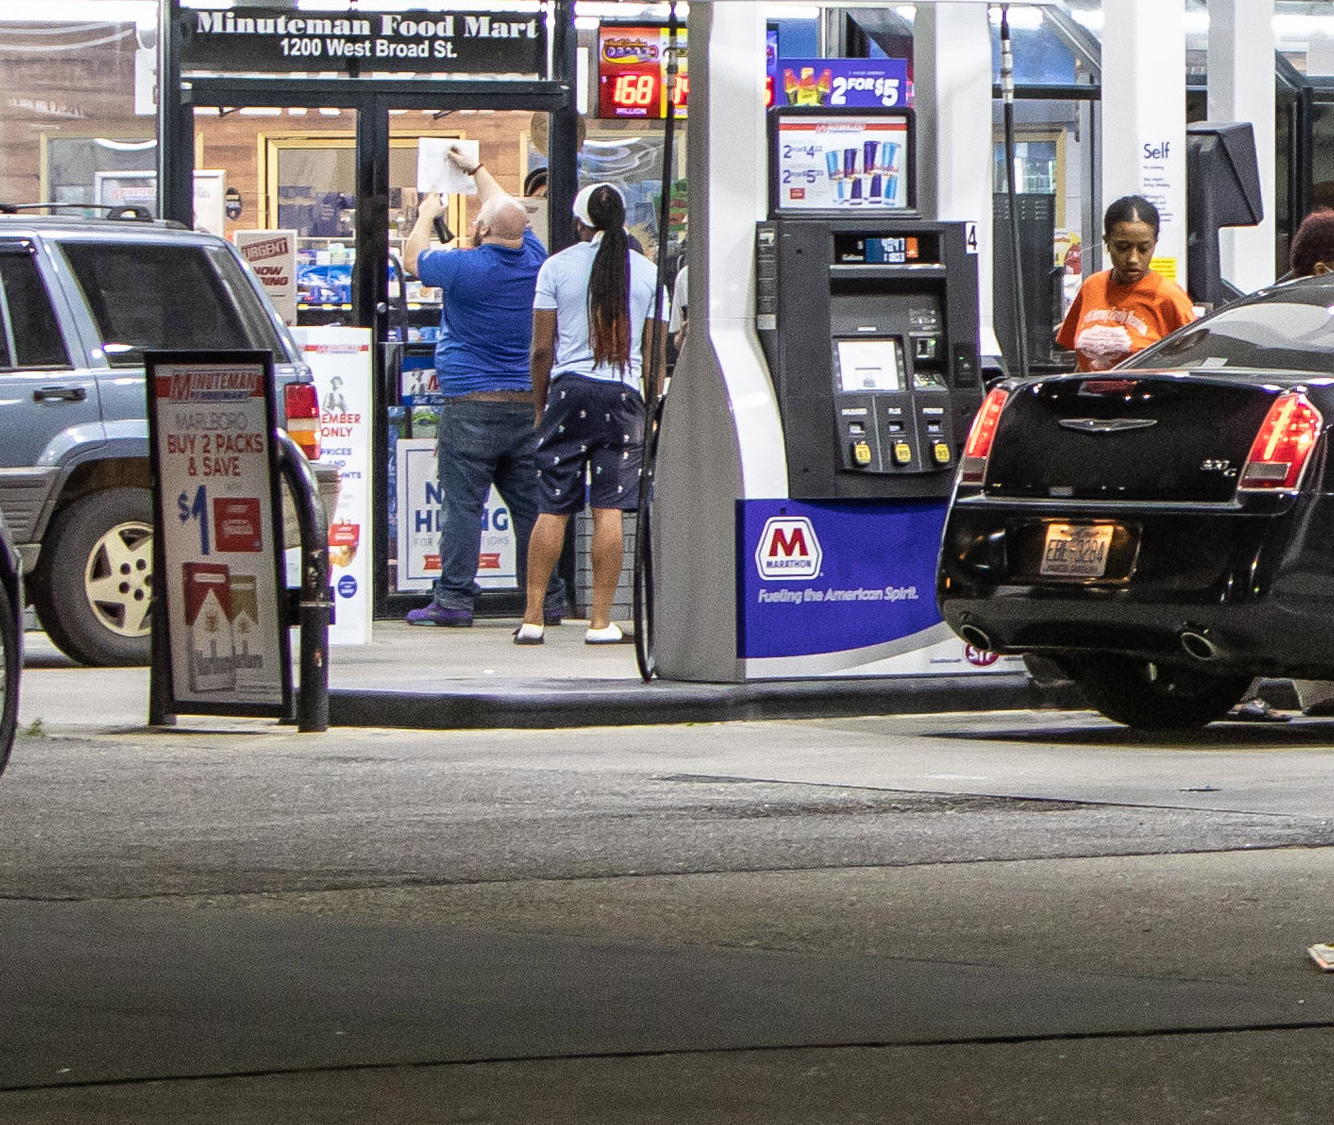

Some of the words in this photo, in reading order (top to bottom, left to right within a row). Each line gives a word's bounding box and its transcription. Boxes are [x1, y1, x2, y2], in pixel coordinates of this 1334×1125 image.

[197, 12, 371, 35] Minuteman
[380, 14, 454, 36] Food
[464, 16, 539, 38] Mart
[280, 40, 321, 57] 1200
[326, 40, 371, 58] West
[375, 41, 431, 58] Broad
[433, 41, 458, 58] St.
[614, 75, 655, 105] 168
[830, 76, 848, 105] 2
[847, 77, 875, 91] FOR
[874, 77, 900, 107] $5
[783, 145, 792, 159] 2
[1143, 141, 1170, 159] Self
[783, 169, 792, 184] 2
[968, 225, 978, 251] 4
[241, 239, 288, 261] URGENT
[169, 372, 259, 401] MINUTEMAN
[175, 411, 248, 431] MARLBORO
[321, 413, 362, 424] EMBER
[321, 427, 353, 437] ONLY
[168, 433, 196, 454] BUY
[202, 434, 211, 454] 2
[216, 433, 264, 454] PACKS
[188, 456, 198, 477] &
[202, 456, 241, 477] SAVE
[177, 484, 210, 556] $1
[768, 528, 809, 557] M
[766, 559, 812, 569] MARATHON
[757, 588, 803, 604] Fueling
[804, 587, 824, 602] the
[823, 586, 883, 603] American
